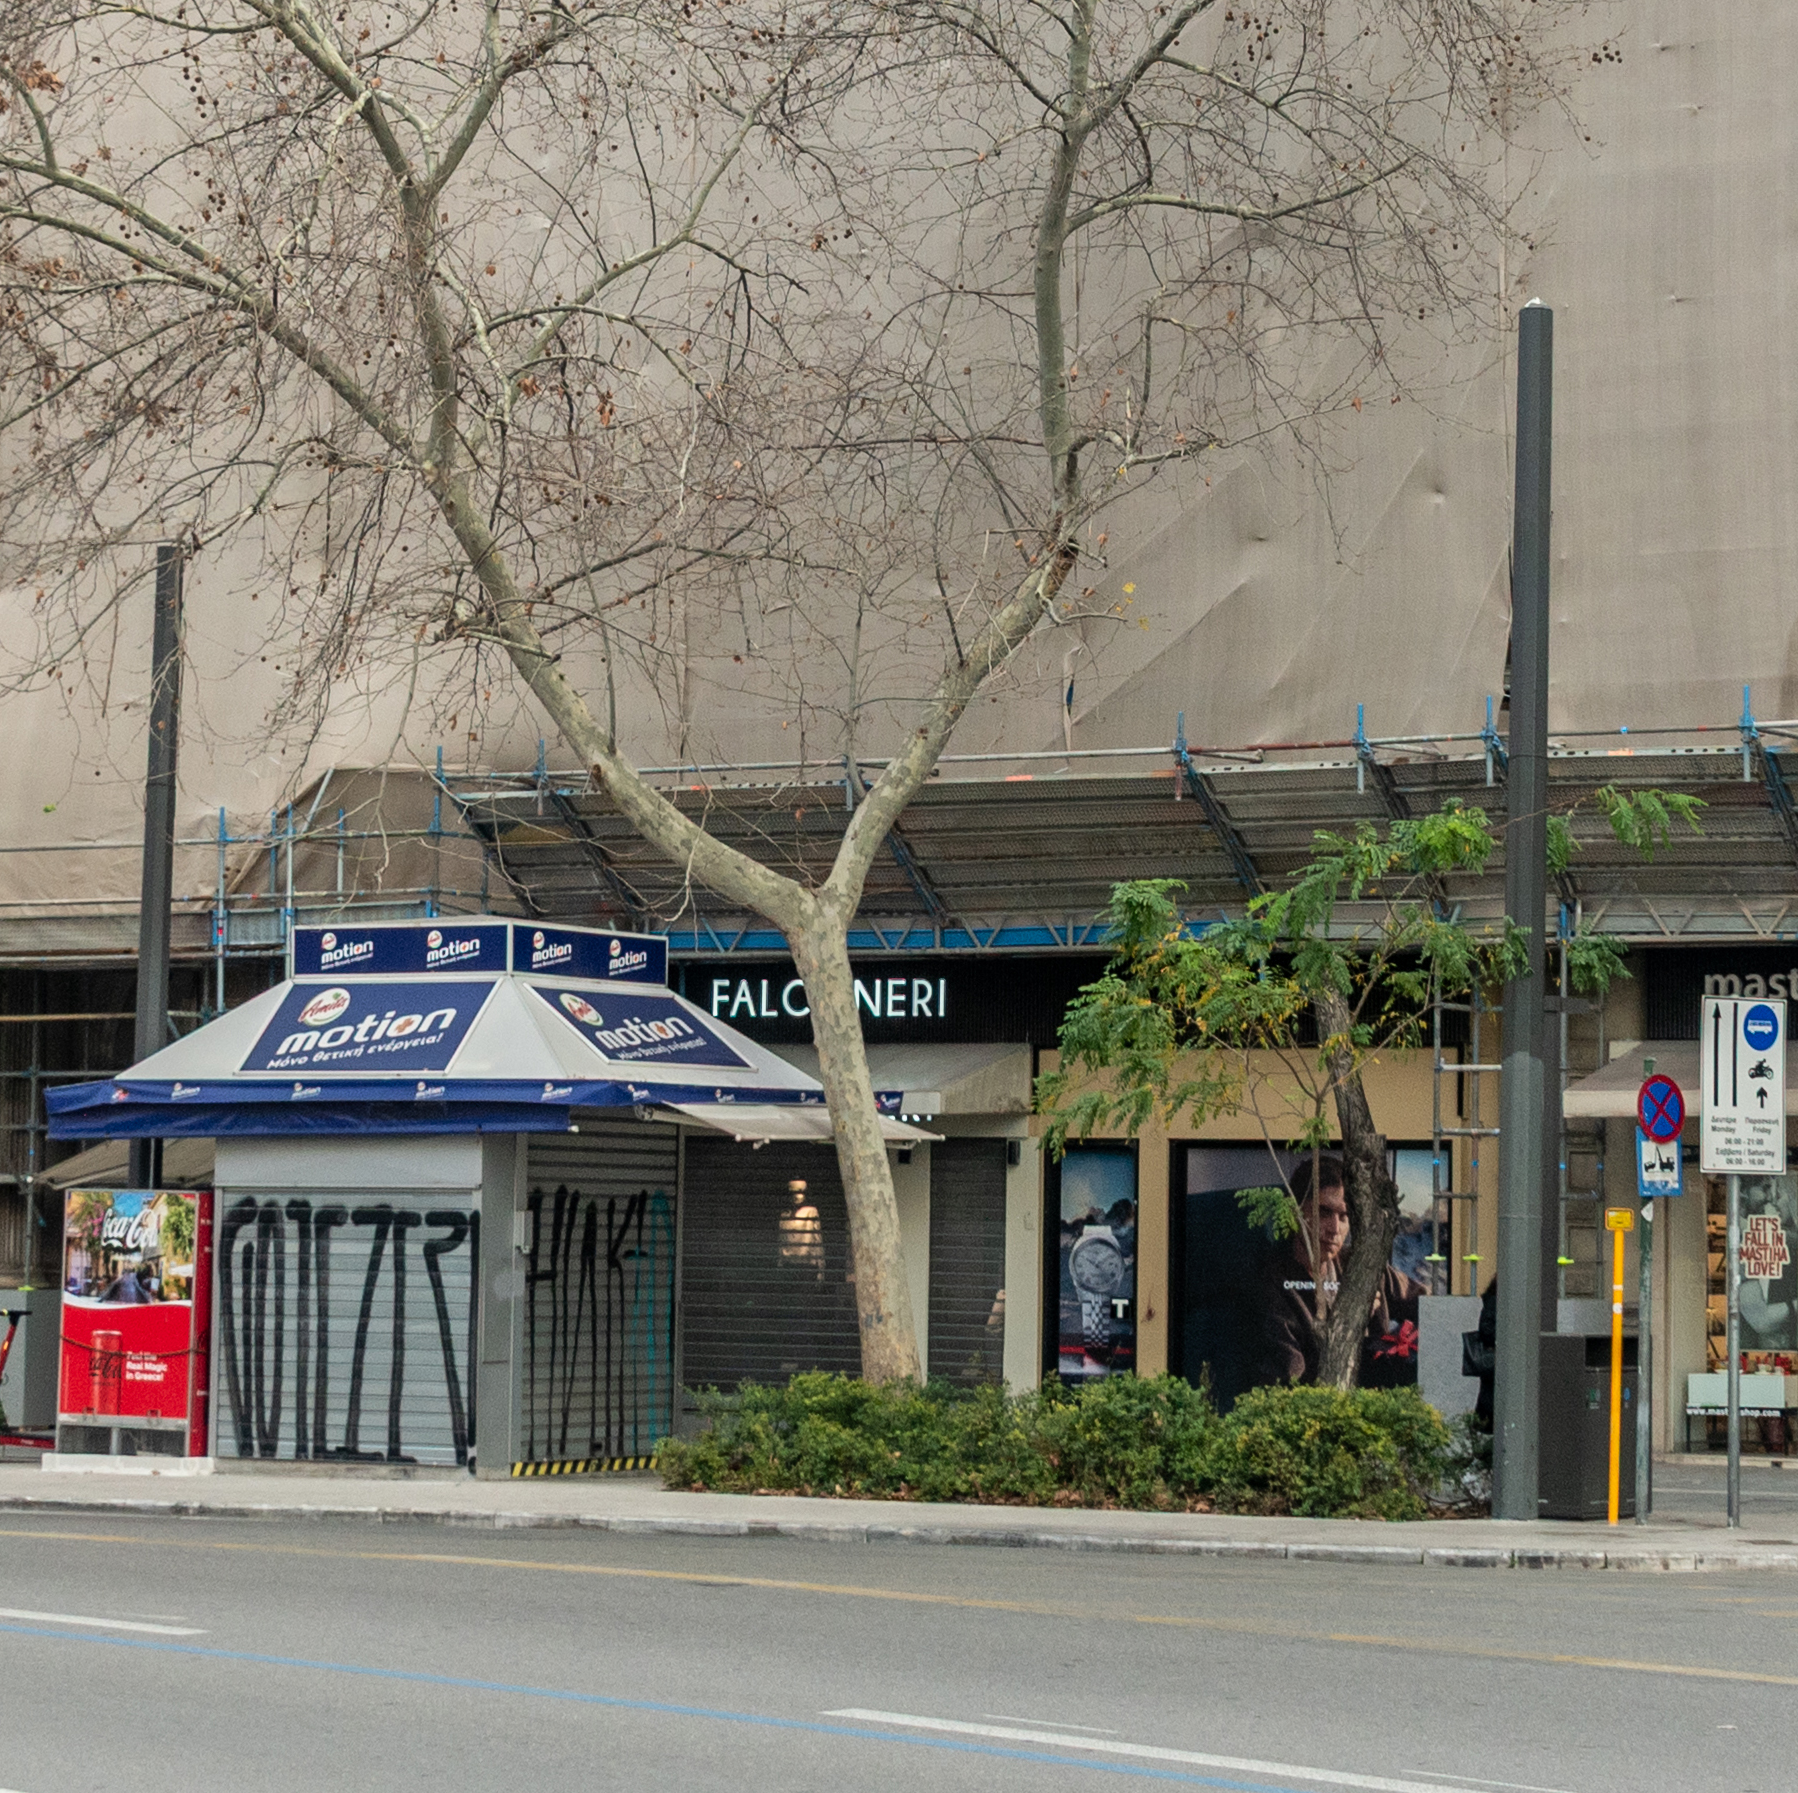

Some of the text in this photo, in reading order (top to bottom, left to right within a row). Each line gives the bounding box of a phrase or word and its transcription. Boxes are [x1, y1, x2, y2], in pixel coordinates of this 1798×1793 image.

[321, 940, 374, 964] motion
[426, 938, 481, 963] motion
[532, 943, 572, 962] motion
[608, 951, 647, 970] motion
[712, 978, 947, 1017] FALCNERI
[275, 1008, 457, 1056] motion
[595, 1016, 695, 1050] motion
[266, 1032, 444, 1070] Μόνο θετική ενέργεια!
[1711, 1125, 1736, 1134] Monday
[1752, 1126, 1772, 1136] Friday
[1747, 1149, 1775, 1158] Saturday
[1749, 1217, 1779, 1232] LET'S
[1744, 1232, 1784, 1247] FALL IN
[1739, 1247, 1788, 1262] MASTIHA
[1748, 1262, 1780, 1277] LOVE!
[1284, 1280, 1316, 1290] OPENIN
[126, 1361, 168, 1373] Real Magic
[1686, 1406, 1781, 1418] www.mastshop.com
